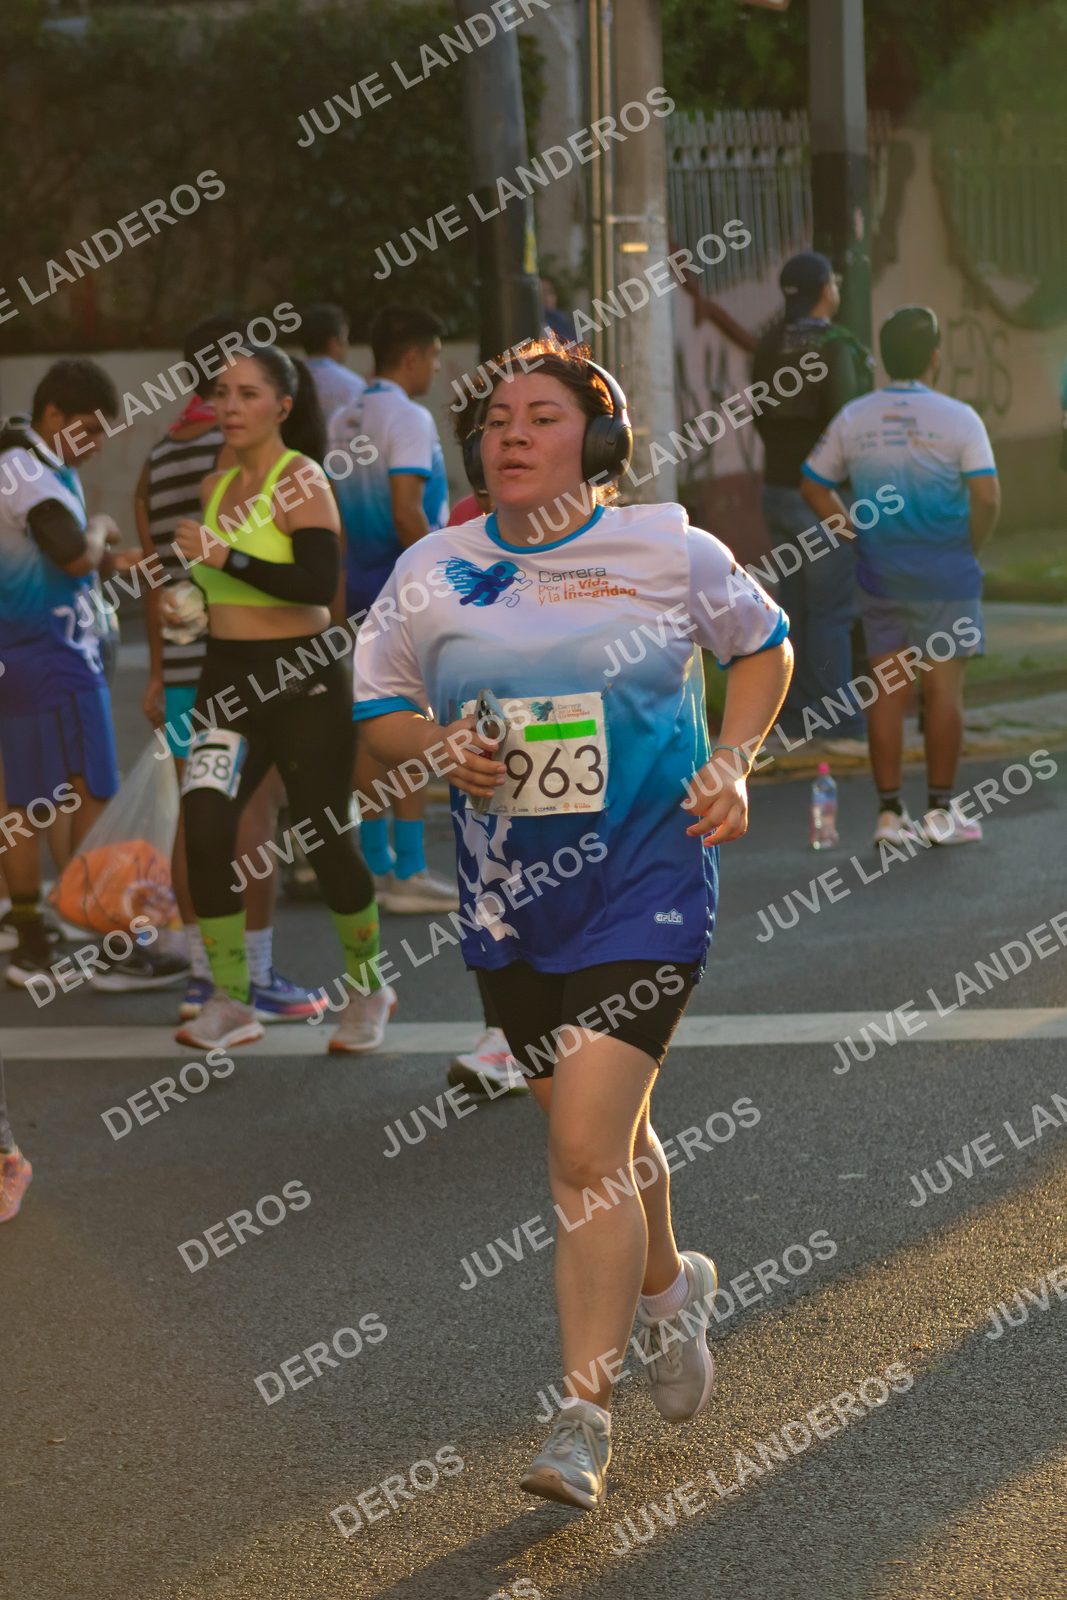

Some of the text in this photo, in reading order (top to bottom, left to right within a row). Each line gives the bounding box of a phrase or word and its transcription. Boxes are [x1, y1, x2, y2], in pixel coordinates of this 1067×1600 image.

[538, 567, 606, 583] Carrera
[538, 577, 609, 595] por la Vida
[539, 594, 546, 606] y
[548, 591, 560, 603] la
[504, 744, 605, 801] 963
